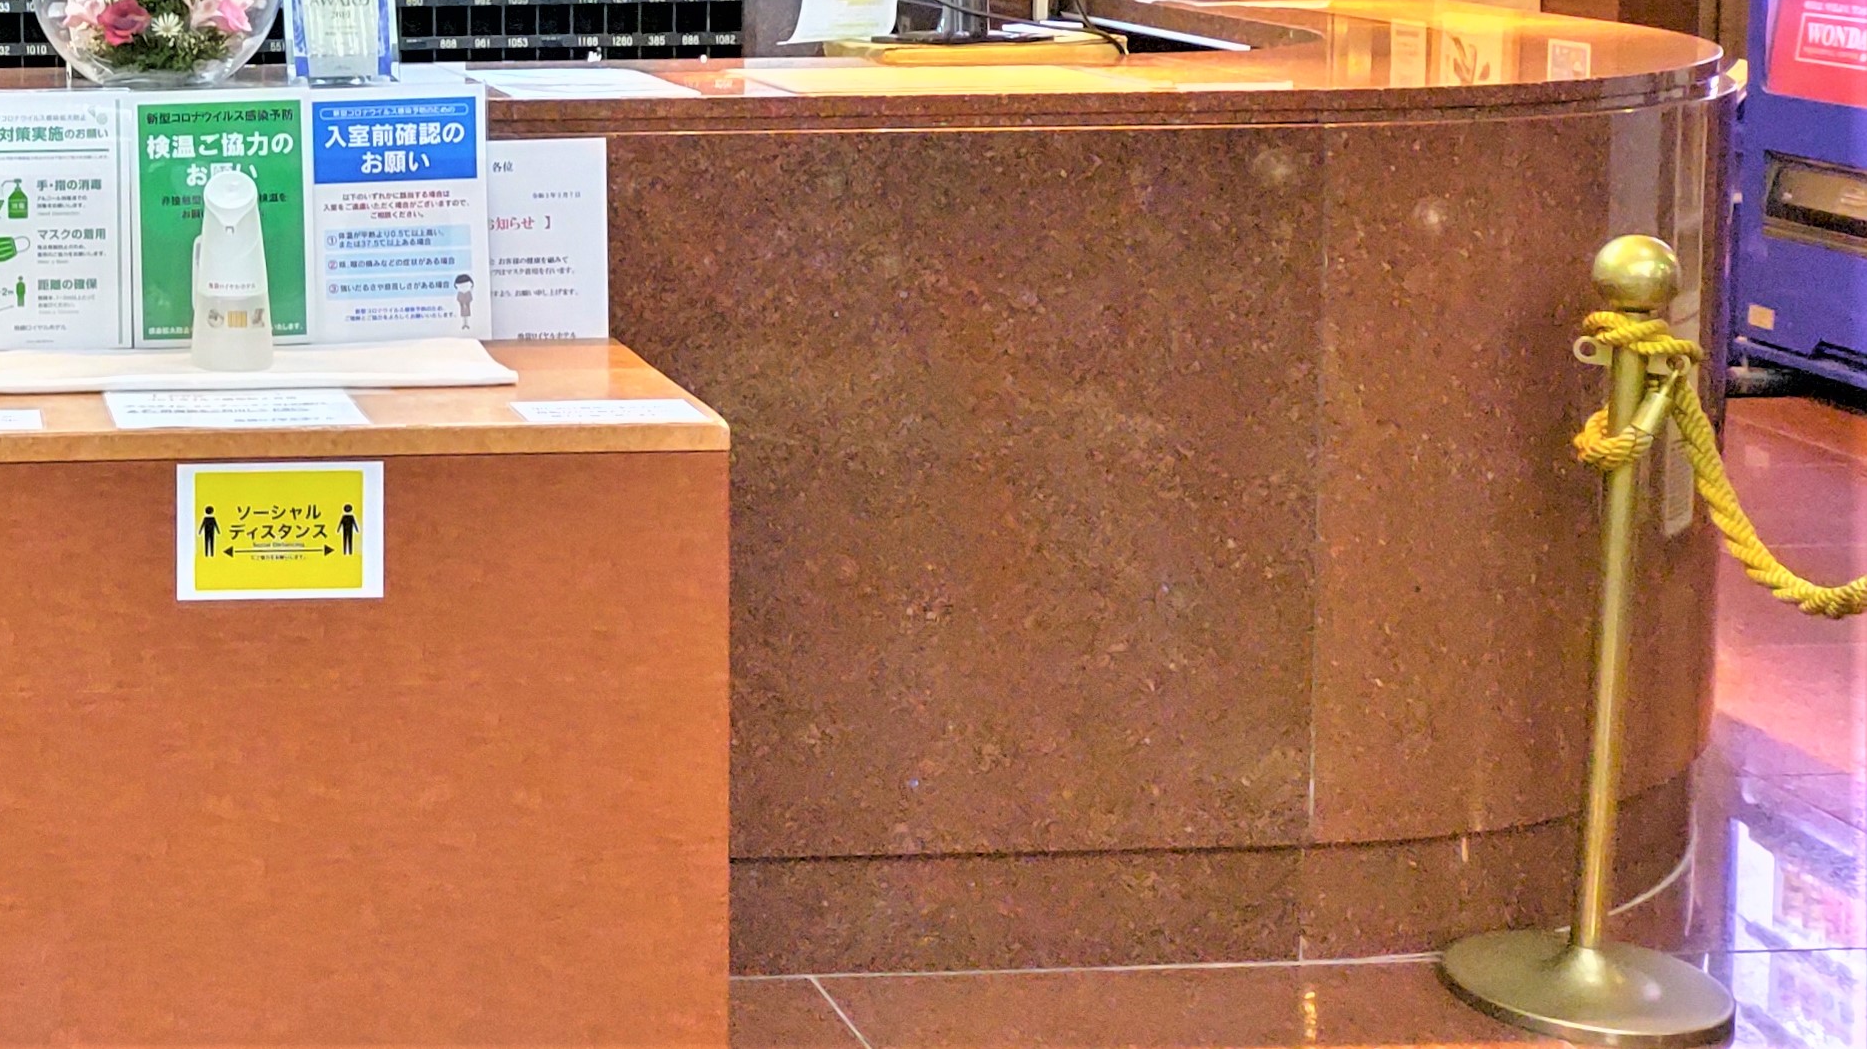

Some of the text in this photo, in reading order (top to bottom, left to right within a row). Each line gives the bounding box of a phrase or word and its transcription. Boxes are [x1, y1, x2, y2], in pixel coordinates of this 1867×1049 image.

[146, 109, 293, 125] 新型コロナウイルス感染予防
[325, 122, 465, 148] 入室前確認の
[146, 131, 294, 159] 検温ご協力の
[361, 150, 429, 174] お願い
[492, 162, 514, 172] 各位
[37, 179, 102, 191] 手・指の消毒
[38, 228, 106, 240] マスクの着用
[38, 279, 97, 290] 距離の確保
[237, 504, 321, 521] ソーシャル
[229, 524, 328, 540] ディスタンス
